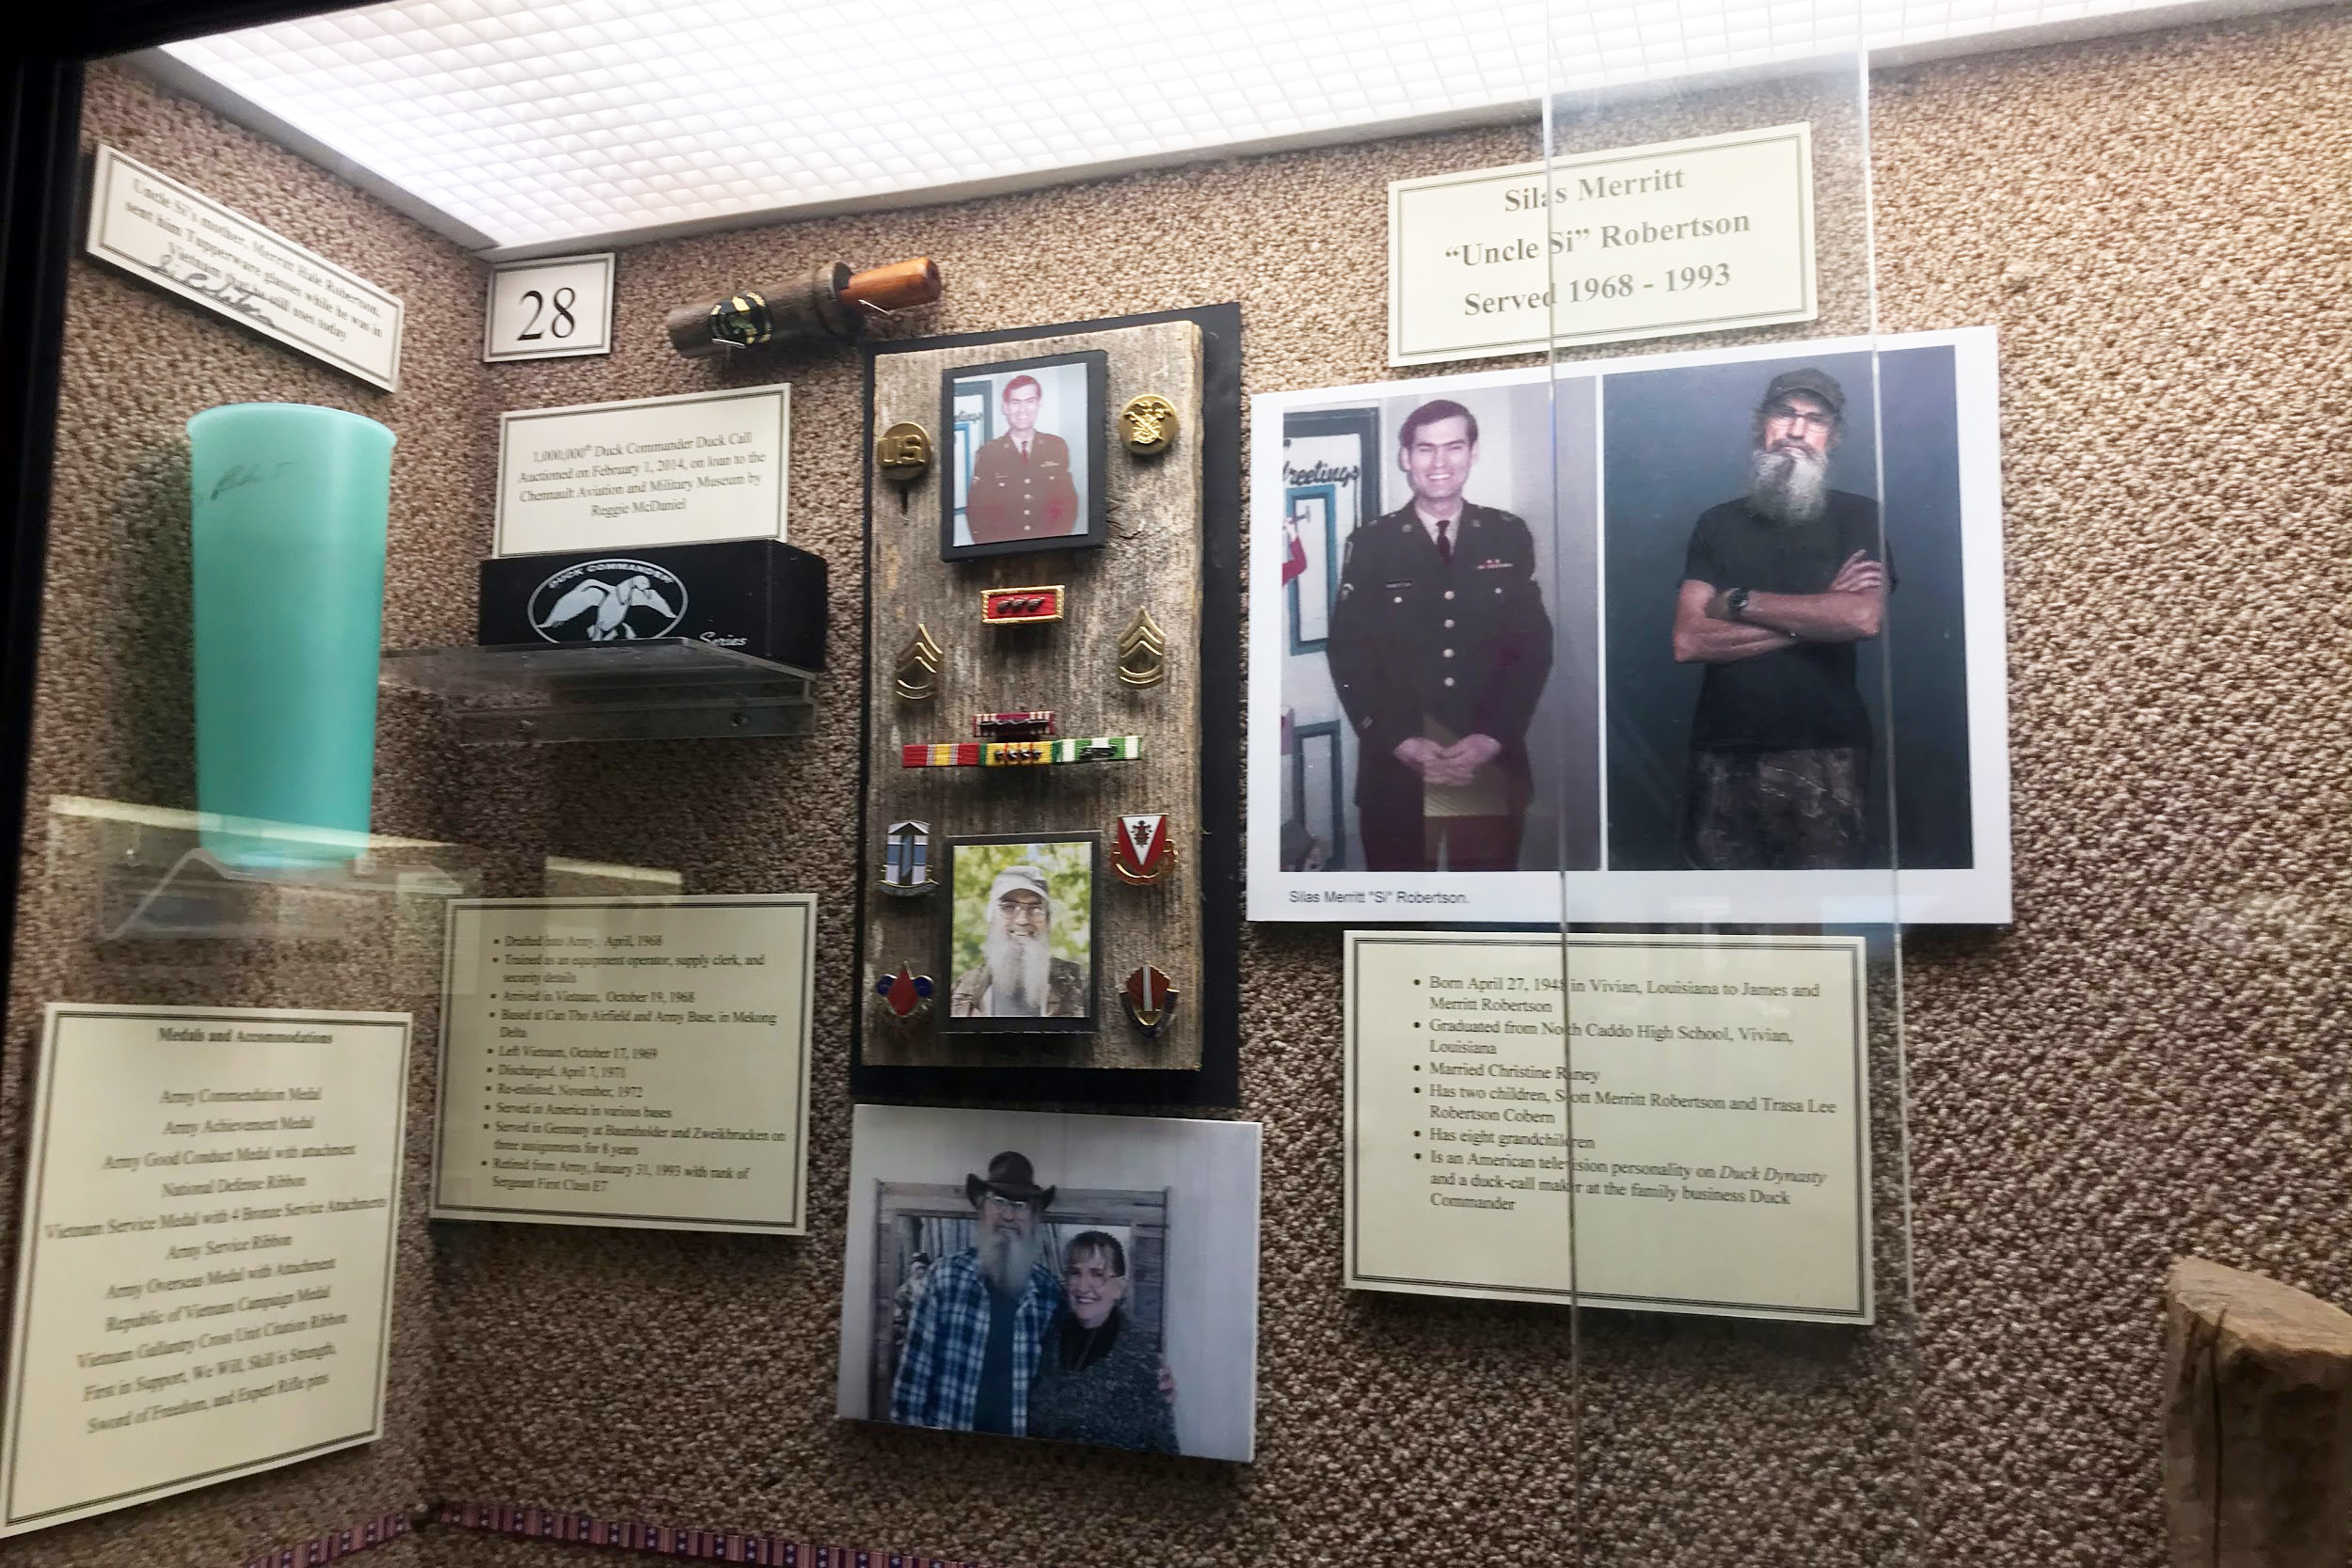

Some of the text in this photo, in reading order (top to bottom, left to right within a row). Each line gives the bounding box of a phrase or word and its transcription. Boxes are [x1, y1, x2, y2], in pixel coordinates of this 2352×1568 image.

[1505, 167, 1687, 212] Silas Merritt
[1445, 238, 1540, 267] “Uncle
[1600, 213, 1752, 249] Robertson
[1464, 281, 1558, 316] Served
[1568, 273, 1634, 305] 1968
[1664, 262, 1731, 293] 1993
[517, 287, 576, 341] 28
[594, 444, 624, 457] Duck
[626, 438, 694, 454] Commander
[696, 434, 726, 448] Duck
[728, 432, 753, 445] Call
[517, 468, 574, 483] Auctioned
[690, 460, 706, 468] on
[747, 451, 766, 463] the
[626, 481, 647, 493] and
[649, 479, 694, 492] Military
[696, 476, 745, 488] Museum
[747, 471, 763, 486] by
[548, 563, 675, 589] DUCK COMMANDER
[699, 631, 748, 647] Series
[1290, 891, 1470, 904] Silas Merritt "Si" Robertson.
[1429, 975, 1464, 989] Born
[1468, 976, 1503, 992] April
[1507, 977, 1530, 992] 27,
[1570, 979, 1585, 992] in
[1589, 979, 1643, 995] Vivian,
[1647, 980, 1719, 994] Louisiana
[1723, 983, 1739, 995] to
[1741, 982, 1788, 996] James
[1791, 983, 1820, 997] and
[1429, 996, 1553, 1012] Merritt Robertson
[1429, 1018, 1794, 1044] Graduated from Noth Caddo High School, Vivian,
[1429, 1039, 1498, 1054] Louisiana
[1429, 1062, 1601, 1085] Married Christine Rney
[1429, 1084, 1837, 1114] Has two children, Sott Merritt Robertson and Trasa Lee
[1429, 1105, 1501, 1121] Robertson
[1429, 1128, 1456, 1141] Has
[1459, 1130, 1495, 1146] eight
[1430, 1150, 1444, 1164] Is
[1446, 1154, 1464, 1164] an
[1468, 1152, 1535, 1168] American
[1612, 1163, 1692, 1180] personality
[1695, 1167, 1716, 1179] on
[1720, 1165, 1760, 1180] Duck
[1763, 1167, 1828, 1186] Dynasty
[1429, 1173, 1456, 1185] and
[1458, 1177, 1468, 1186] a
[1470, 1174, 1535, 1190] duck-call
[1586, 1183, 1600, 1195] at
[1604, 1182, 1627, 1196] the
[1630, 1183, 1678, 1201] family
[1681, 1185, 1746, 1203] business
[1750, 1189, 1791, 1204] Duck
[1430, 1193, 1517, 1211] Commander
